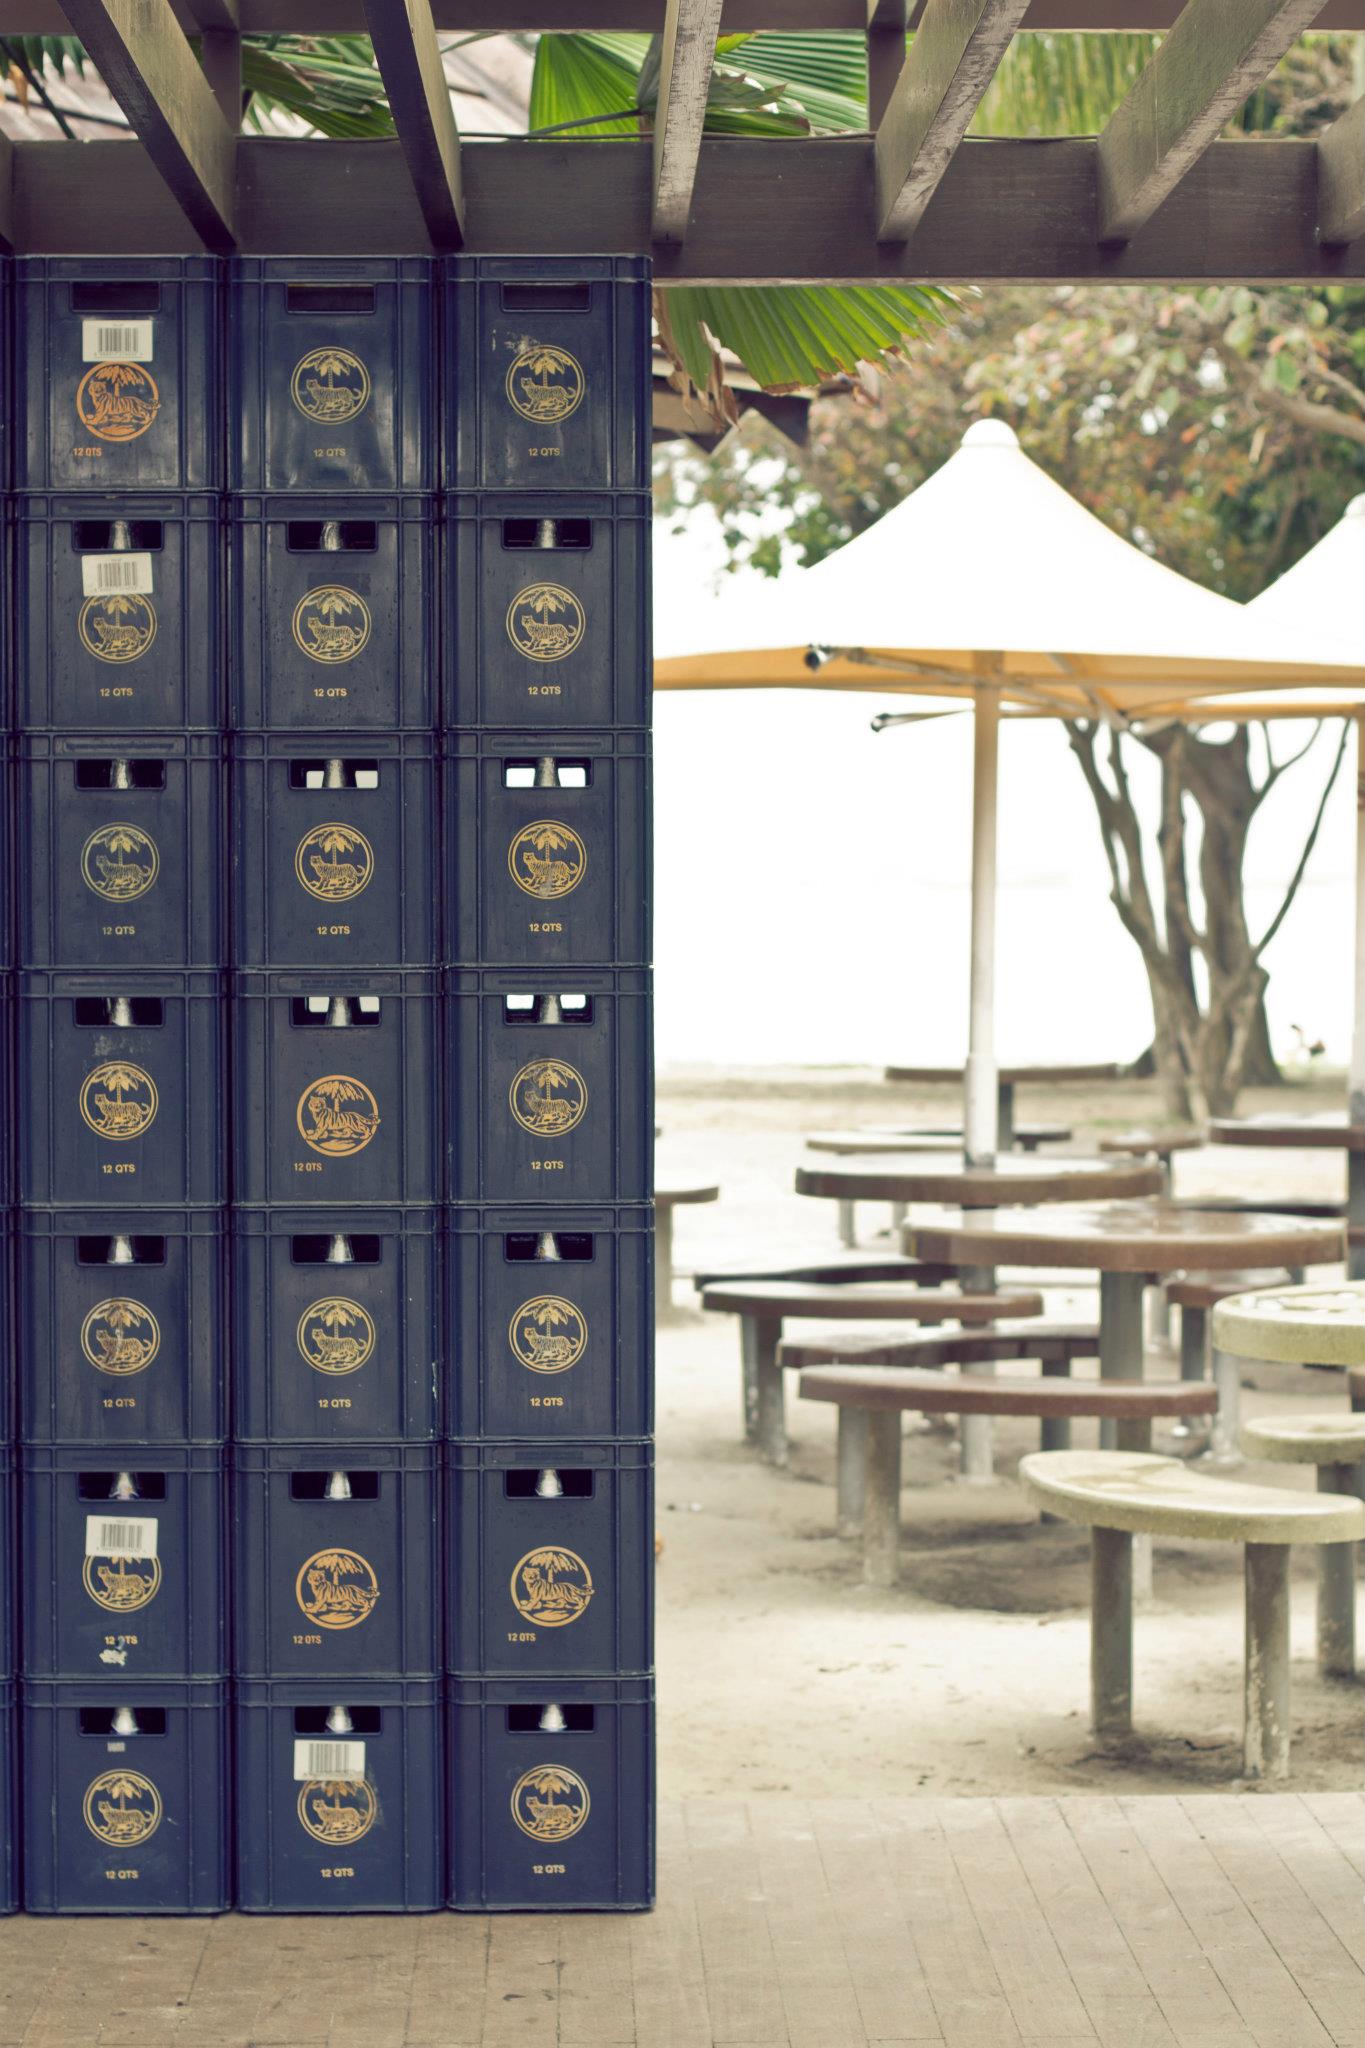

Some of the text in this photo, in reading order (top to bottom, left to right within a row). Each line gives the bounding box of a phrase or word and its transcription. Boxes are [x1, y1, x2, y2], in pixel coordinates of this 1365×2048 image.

[73, 447, 102, 456] 12 QTS
[313, 448, 346, 457] 12 QTS
[528, 447, 561, 457] 12 QTS
[100, 687, 134, 697] 12 QTS
[314, 687, 348, 697] 12 QTS
[527, 686, 561, 695] 12 QTS
[102, 926, 136, 935] 12 QTS
[317, 925, 351, 935] 12 QTS
[529, 923, 562, 932] 12 QTS
[102, 1164, 136, 1174] 12 QTS
[294, 1162, 323, 1172] 12 QTS
[530, 1160, 564, 1170] 12 QTS
[102, 1398, 136, 1408] 12 QTS
[318, 1398, 352, 1408] 12 QTS
[530, 1397, 564, 1407] 12 QTS
[104, 1635, 115, 1645] 12
[293, 1635, 322, 1645] 12 QTS
[507, 1632, 536, 1642] 12 QTS
[320, 1867, 355, 1878] 12 QTS
[532, 1864, 566, 1874] 12 QTS
[105, 1870, 139, 1880] 12 QTS
